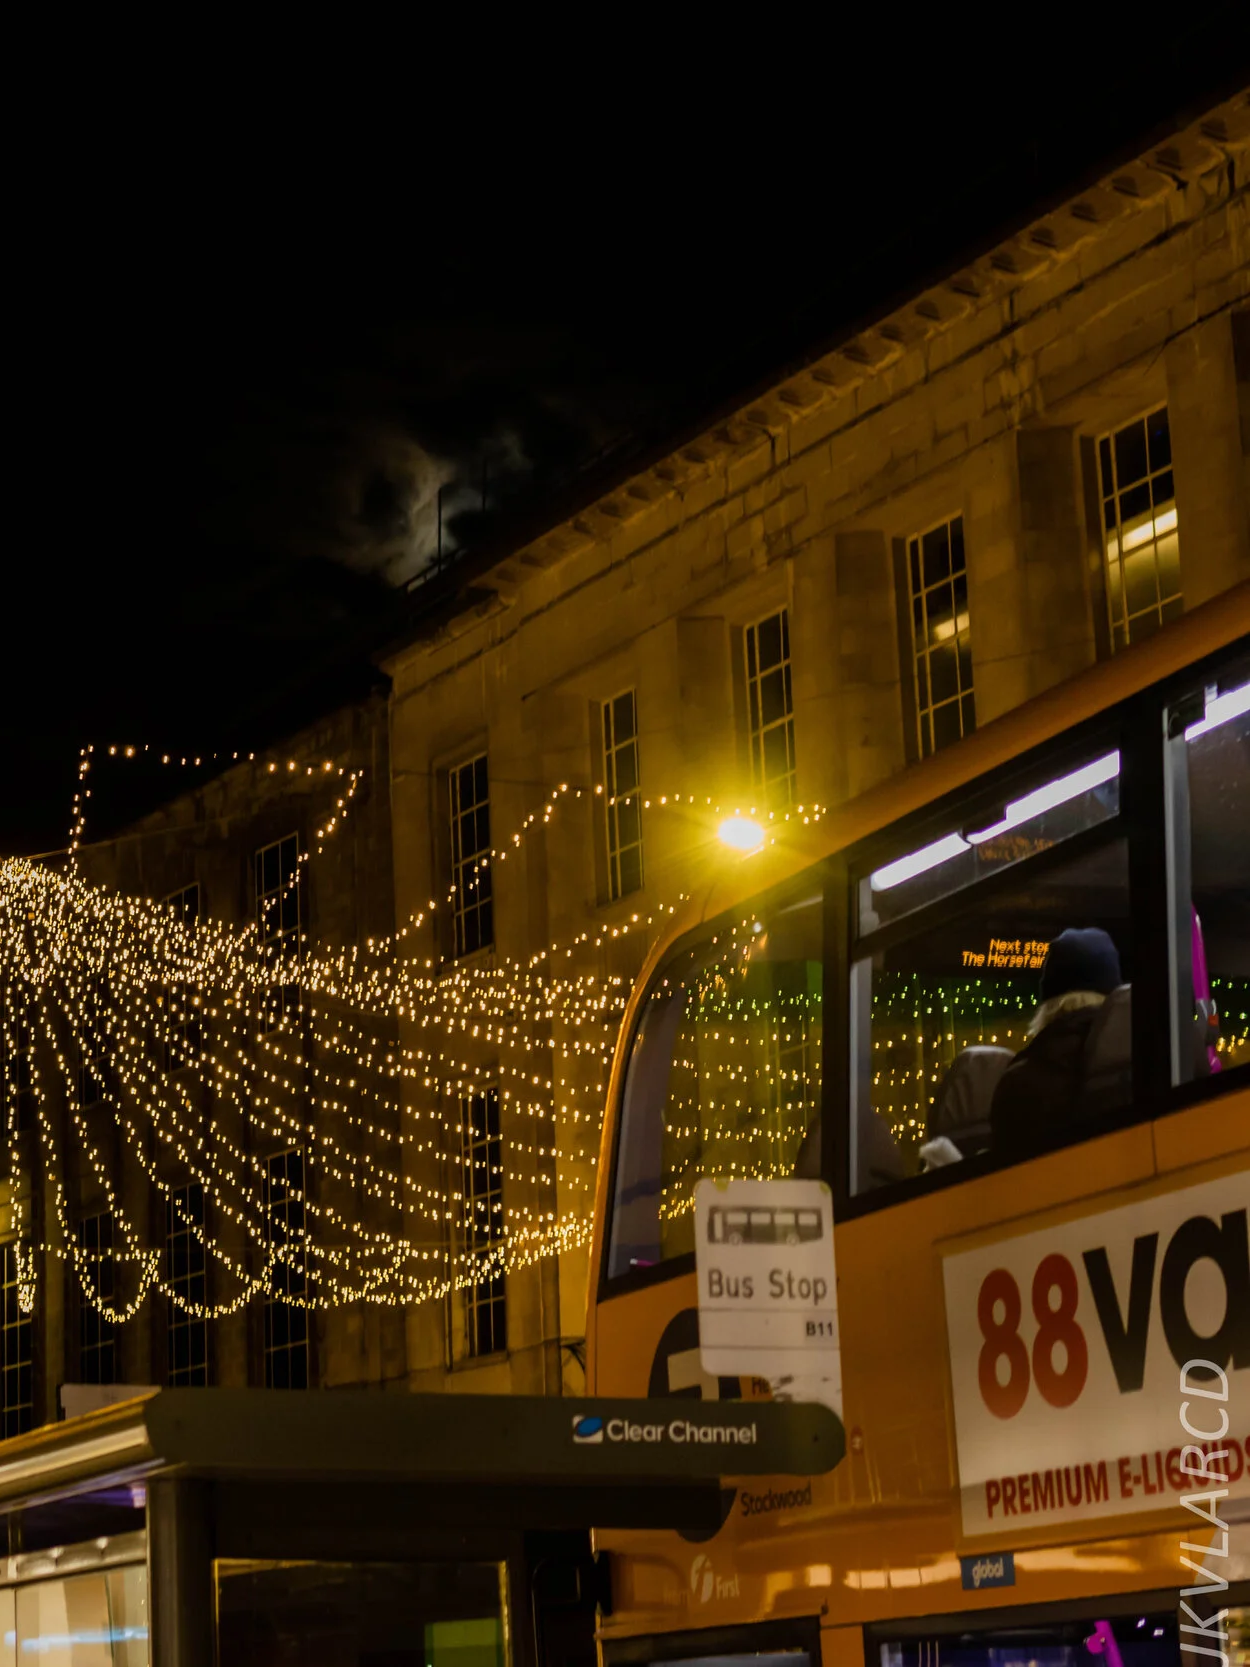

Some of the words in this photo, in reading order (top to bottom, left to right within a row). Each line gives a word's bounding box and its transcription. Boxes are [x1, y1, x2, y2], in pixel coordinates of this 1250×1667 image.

[962, 950, 985, 967] The
[987, 951, 1047, 969] Horsefair
[989, 938, 1021, 954] Next
[708, 1267, 754, 1298] Bus
[768, 1267, 827, 1306] Stop
[806, 1320, 834, 1336] B11
[606, 1418, 664, 1443] Clear
[668, 1420, 757, 1445] Channel
[985, 1460, 1110, 1519] PREMIUM
[1118, 1434, 1250, 1499] E-LIQUID
[972, 1557, 1004, 1588] global
